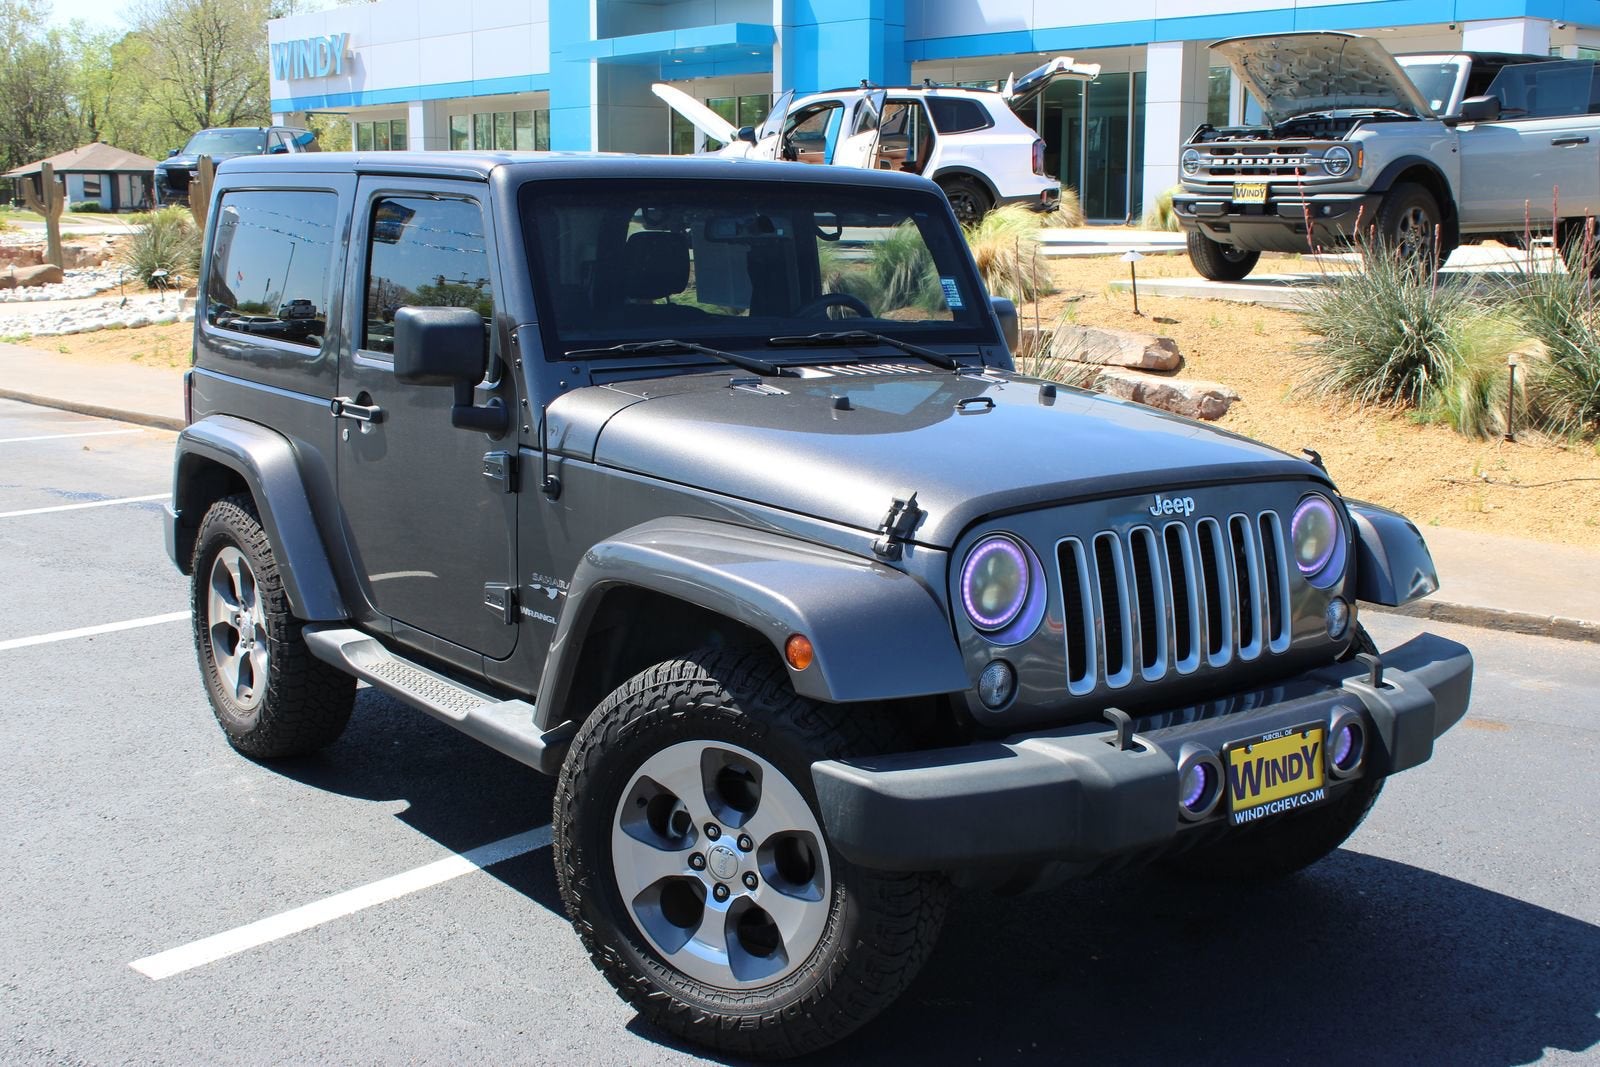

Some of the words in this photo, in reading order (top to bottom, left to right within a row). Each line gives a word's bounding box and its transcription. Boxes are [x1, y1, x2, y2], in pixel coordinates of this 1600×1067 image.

[271, 32, 350, 81] WINDY
[1235, 187, 1266, 198] WINDY
[1149, 494, 1195, 517] Jeep
[1231, 741, 1319, 801] WINDY
[1234, 788, 1325, 824] WINDYCHEV.COM
